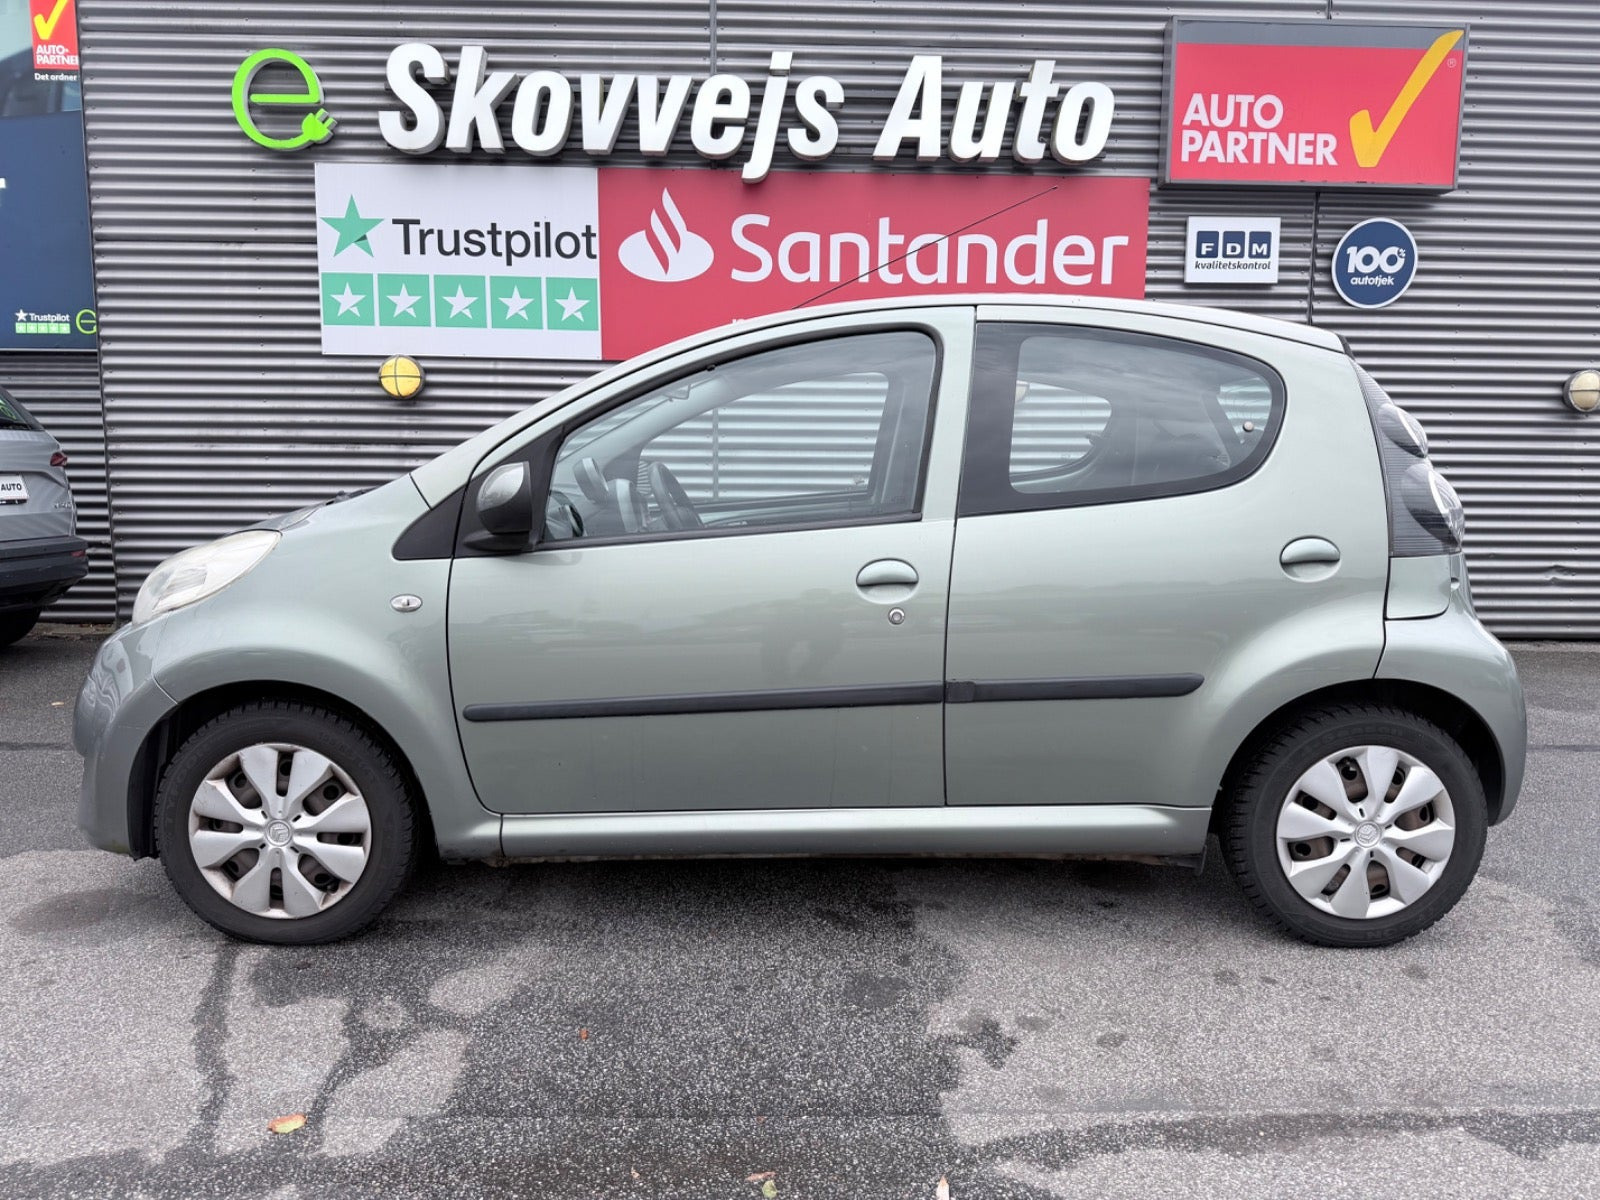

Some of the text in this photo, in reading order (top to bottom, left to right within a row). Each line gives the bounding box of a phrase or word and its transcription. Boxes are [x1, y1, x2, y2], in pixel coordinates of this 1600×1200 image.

[34, 73, 77, 81] Det ordner
[378, 42, 1115, 182] Skovvejs Auto
[1181, 92, 1284, 129] AUTO
[1180, 129, 1339, 166] PARTNER
[391, 218, 598, 267] Trustpilot
[730, 213, 1129, 286] Santander
[1195, 260, 1271, 271] kvalitetskontrol
[1350, 275, 1395, 287] autotjek
[29, 313, 70, 323] Trustpilot
[1, 483, 22, 491] AUTO
